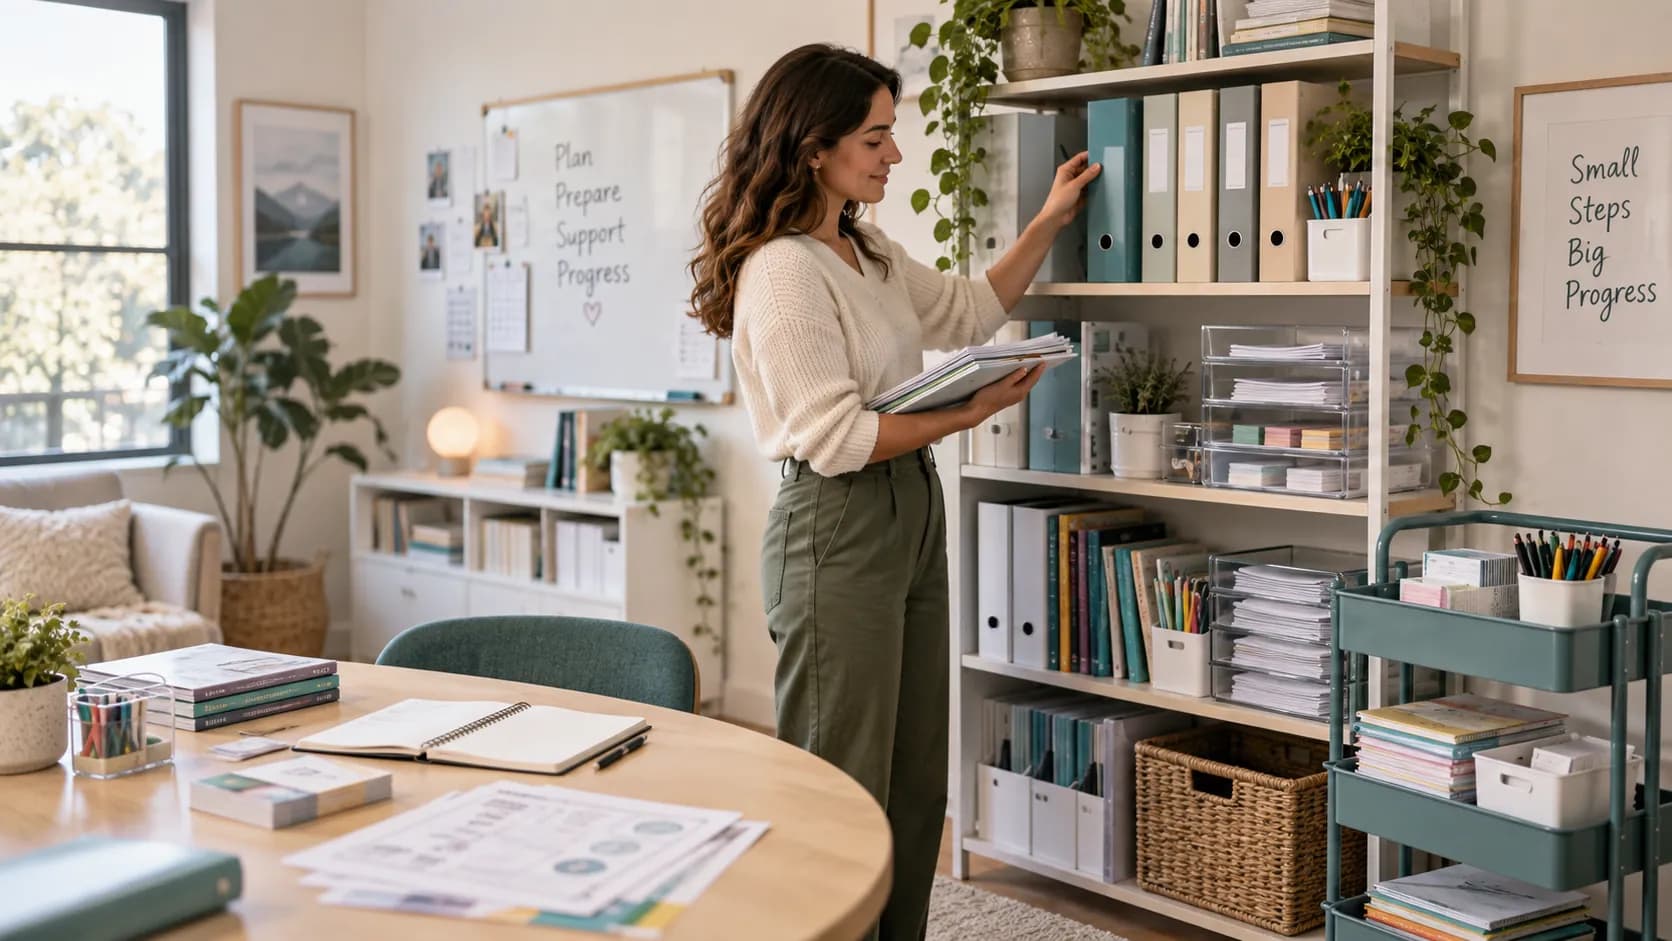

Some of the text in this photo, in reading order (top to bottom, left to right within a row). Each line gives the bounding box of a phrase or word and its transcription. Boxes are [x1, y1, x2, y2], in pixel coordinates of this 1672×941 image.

[555, 140, 594, 172] Plan
[1570, 146, 1640, 184] Small
[556, 182, 622, 216] Prepare
[1569, 196, 1631, 232] Steps
[556, 218, 626, 256] Support
[1568, 237, 1611, 277] Big
[557, 260, 631, 298] Progress
[1566, 280, 1657, 322] Progress
